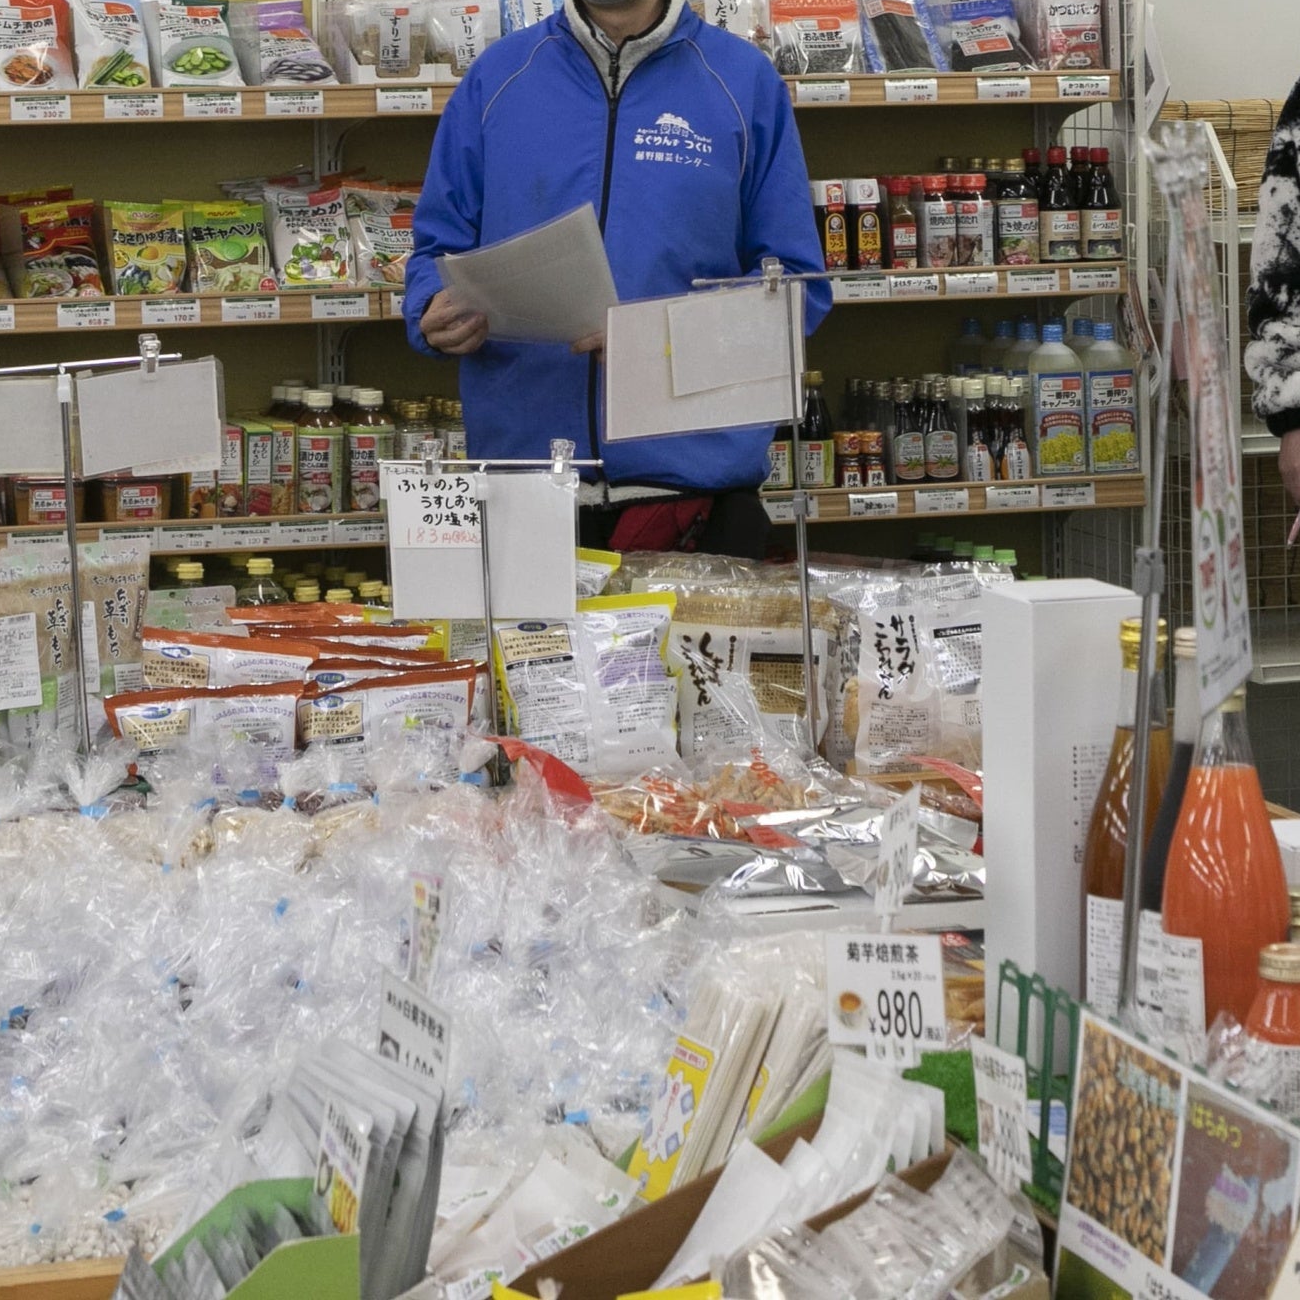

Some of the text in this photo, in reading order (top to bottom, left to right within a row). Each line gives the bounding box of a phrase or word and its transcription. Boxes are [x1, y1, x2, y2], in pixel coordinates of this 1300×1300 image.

[846, 941, 920, 965] 菊芋焙煎茶
